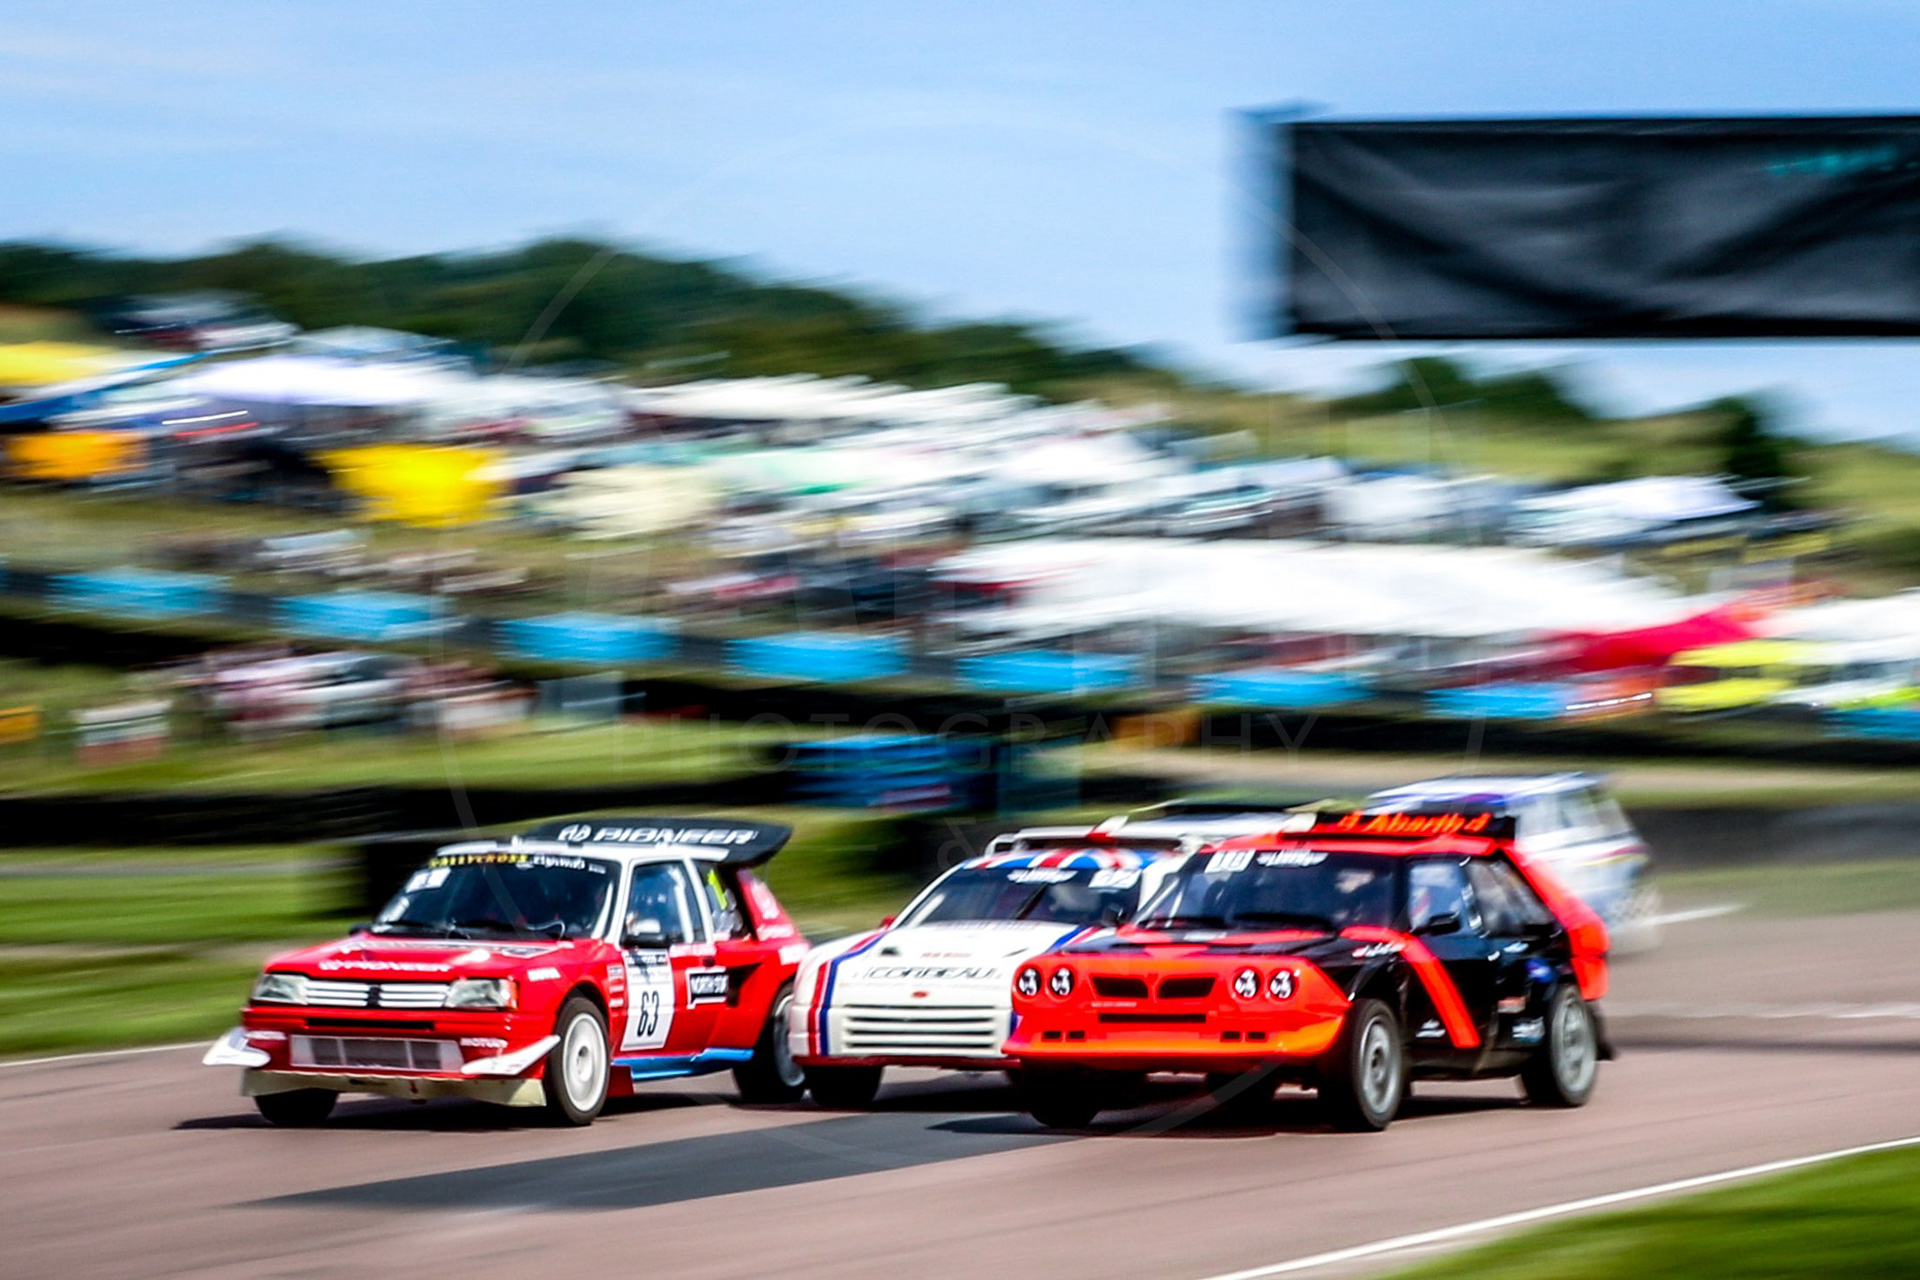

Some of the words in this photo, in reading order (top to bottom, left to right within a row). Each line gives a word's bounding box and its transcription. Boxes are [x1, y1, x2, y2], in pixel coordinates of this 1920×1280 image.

[593, 826, 756, 845] PIONEER
[869, 965, 997, 980] CORBEAU
[637, 988, 660, 1037] 63
